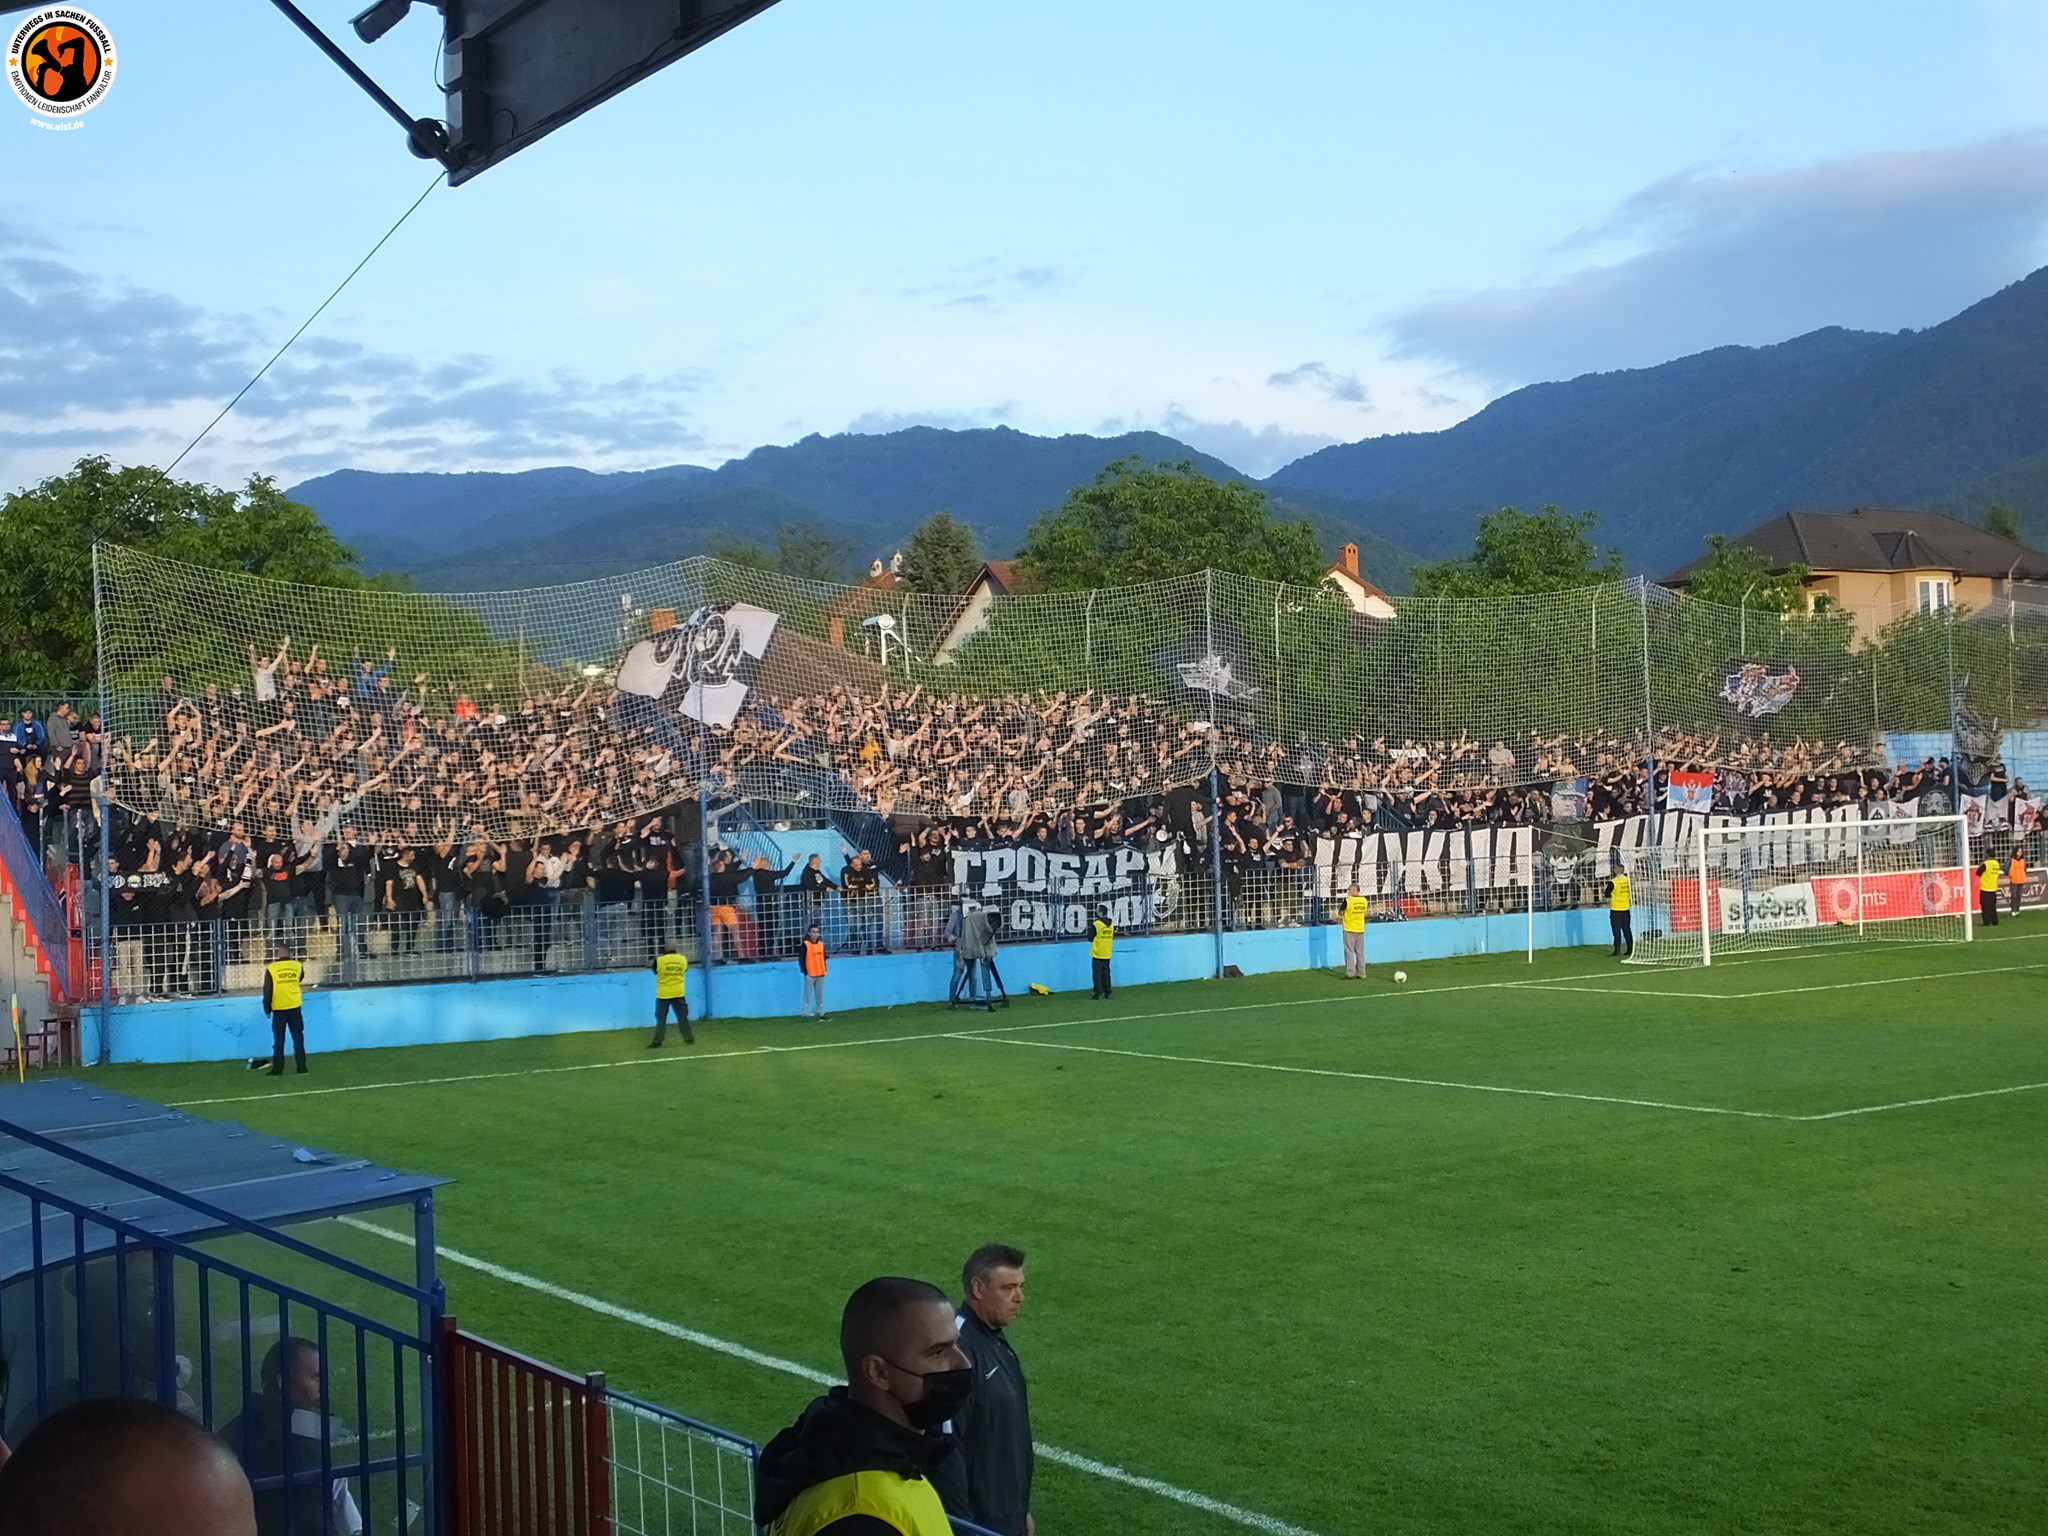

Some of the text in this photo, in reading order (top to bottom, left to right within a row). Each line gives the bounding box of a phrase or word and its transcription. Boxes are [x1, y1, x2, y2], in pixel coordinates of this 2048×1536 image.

[951, 844, 1178, 897] ГРОБАРИ
[1861, 889, 1887, 906] mts
[1728, 917, 1810, 931] wwsoccerbet.rs
